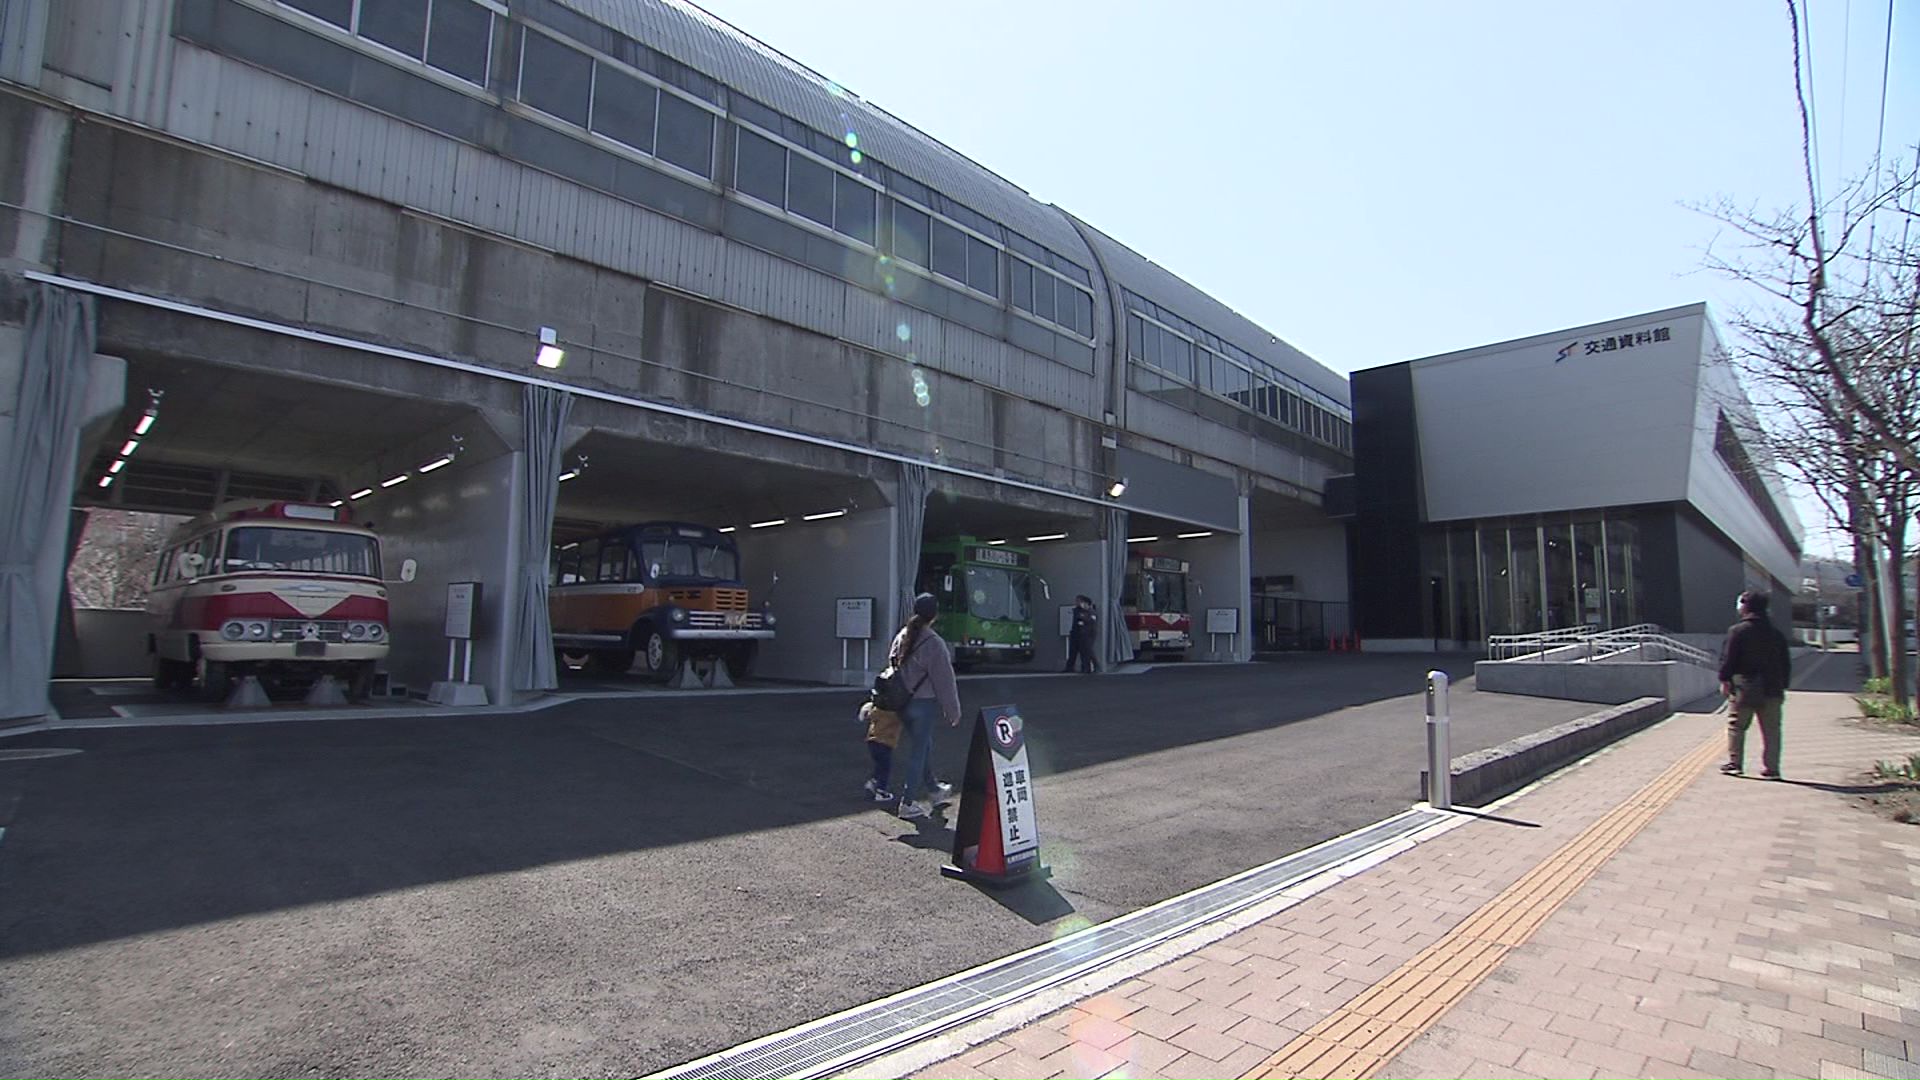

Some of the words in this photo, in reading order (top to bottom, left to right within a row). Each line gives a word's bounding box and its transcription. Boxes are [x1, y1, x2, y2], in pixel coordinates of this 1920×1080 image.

[1584, 327, 1671, 355] 交通資料館
[1014, 769, 1028, 803] 車両
[1002, 771, 1020, 841] 進入禁止
